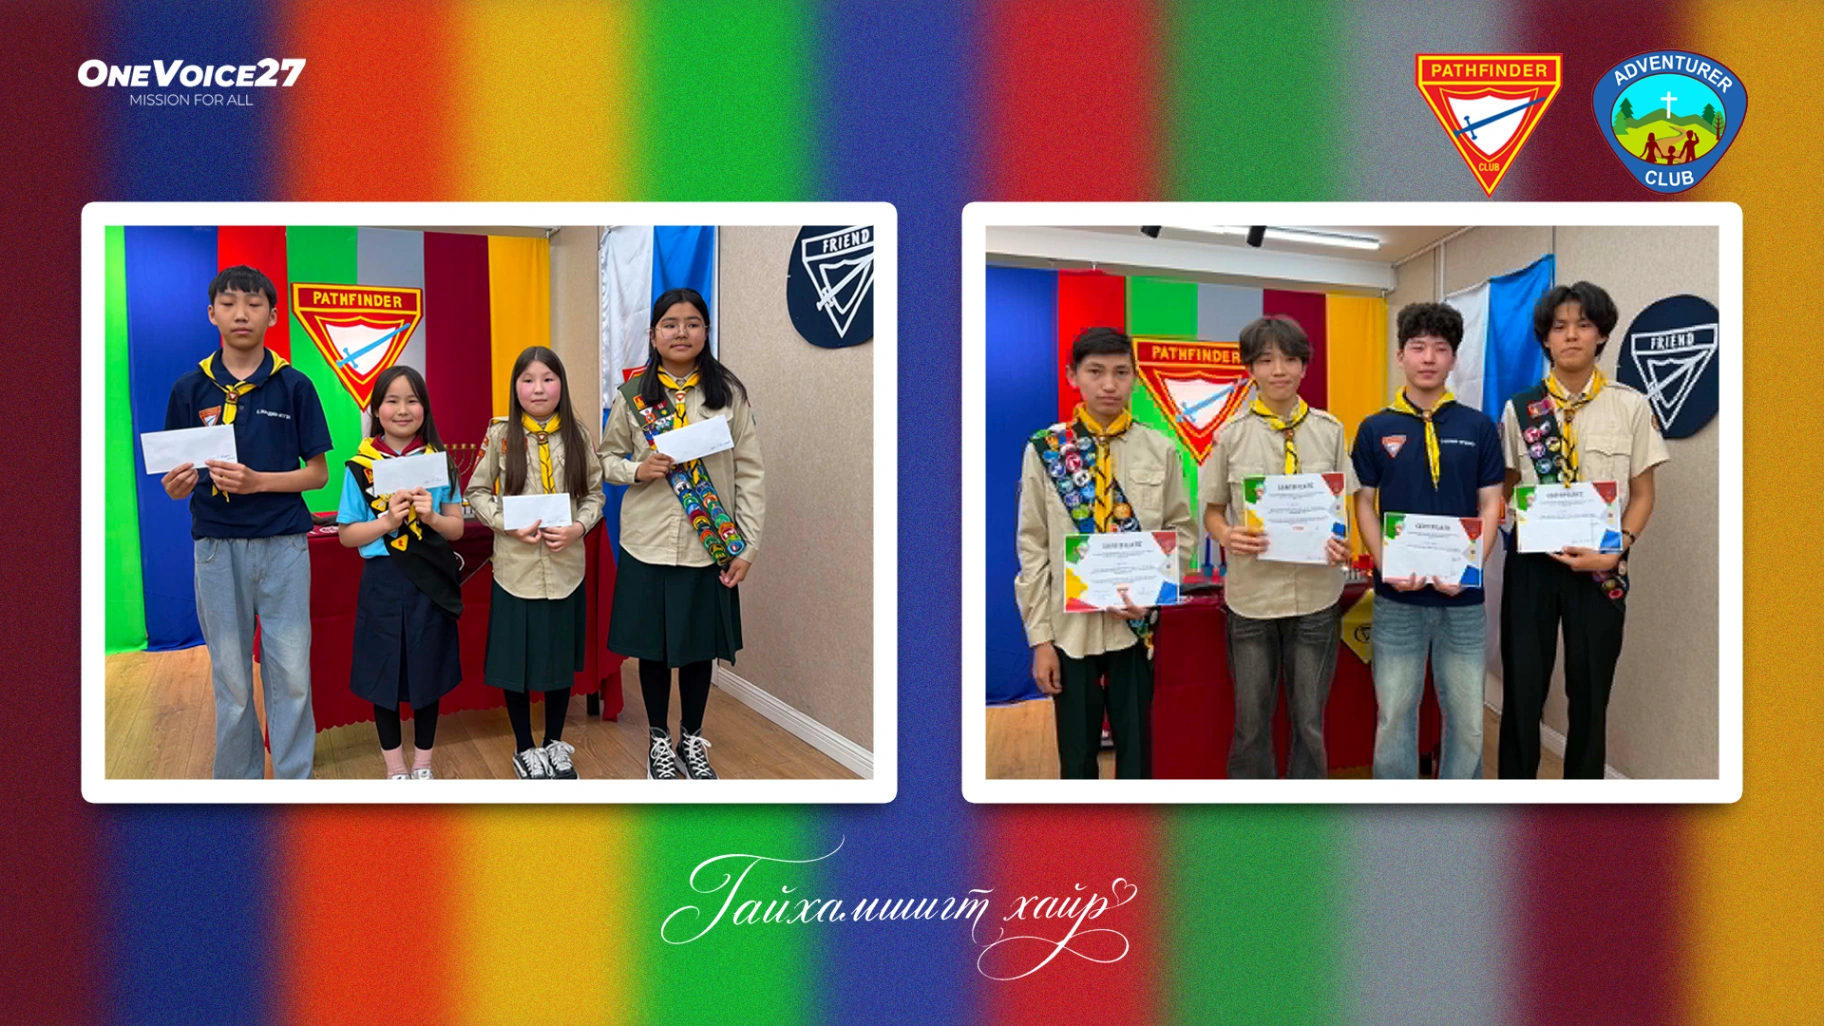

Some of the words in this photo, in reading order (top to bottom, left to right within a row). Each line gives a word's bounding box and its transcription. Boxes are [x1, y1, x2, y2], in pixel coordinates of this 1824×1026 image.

[822, 228, 870, 253] FRIEND
[312, 291, 403, 309] PATHFINDER
[1650, 332, 1695, 351] FRIEND
[1152, 345, 1242, 364] PATHFINDER
